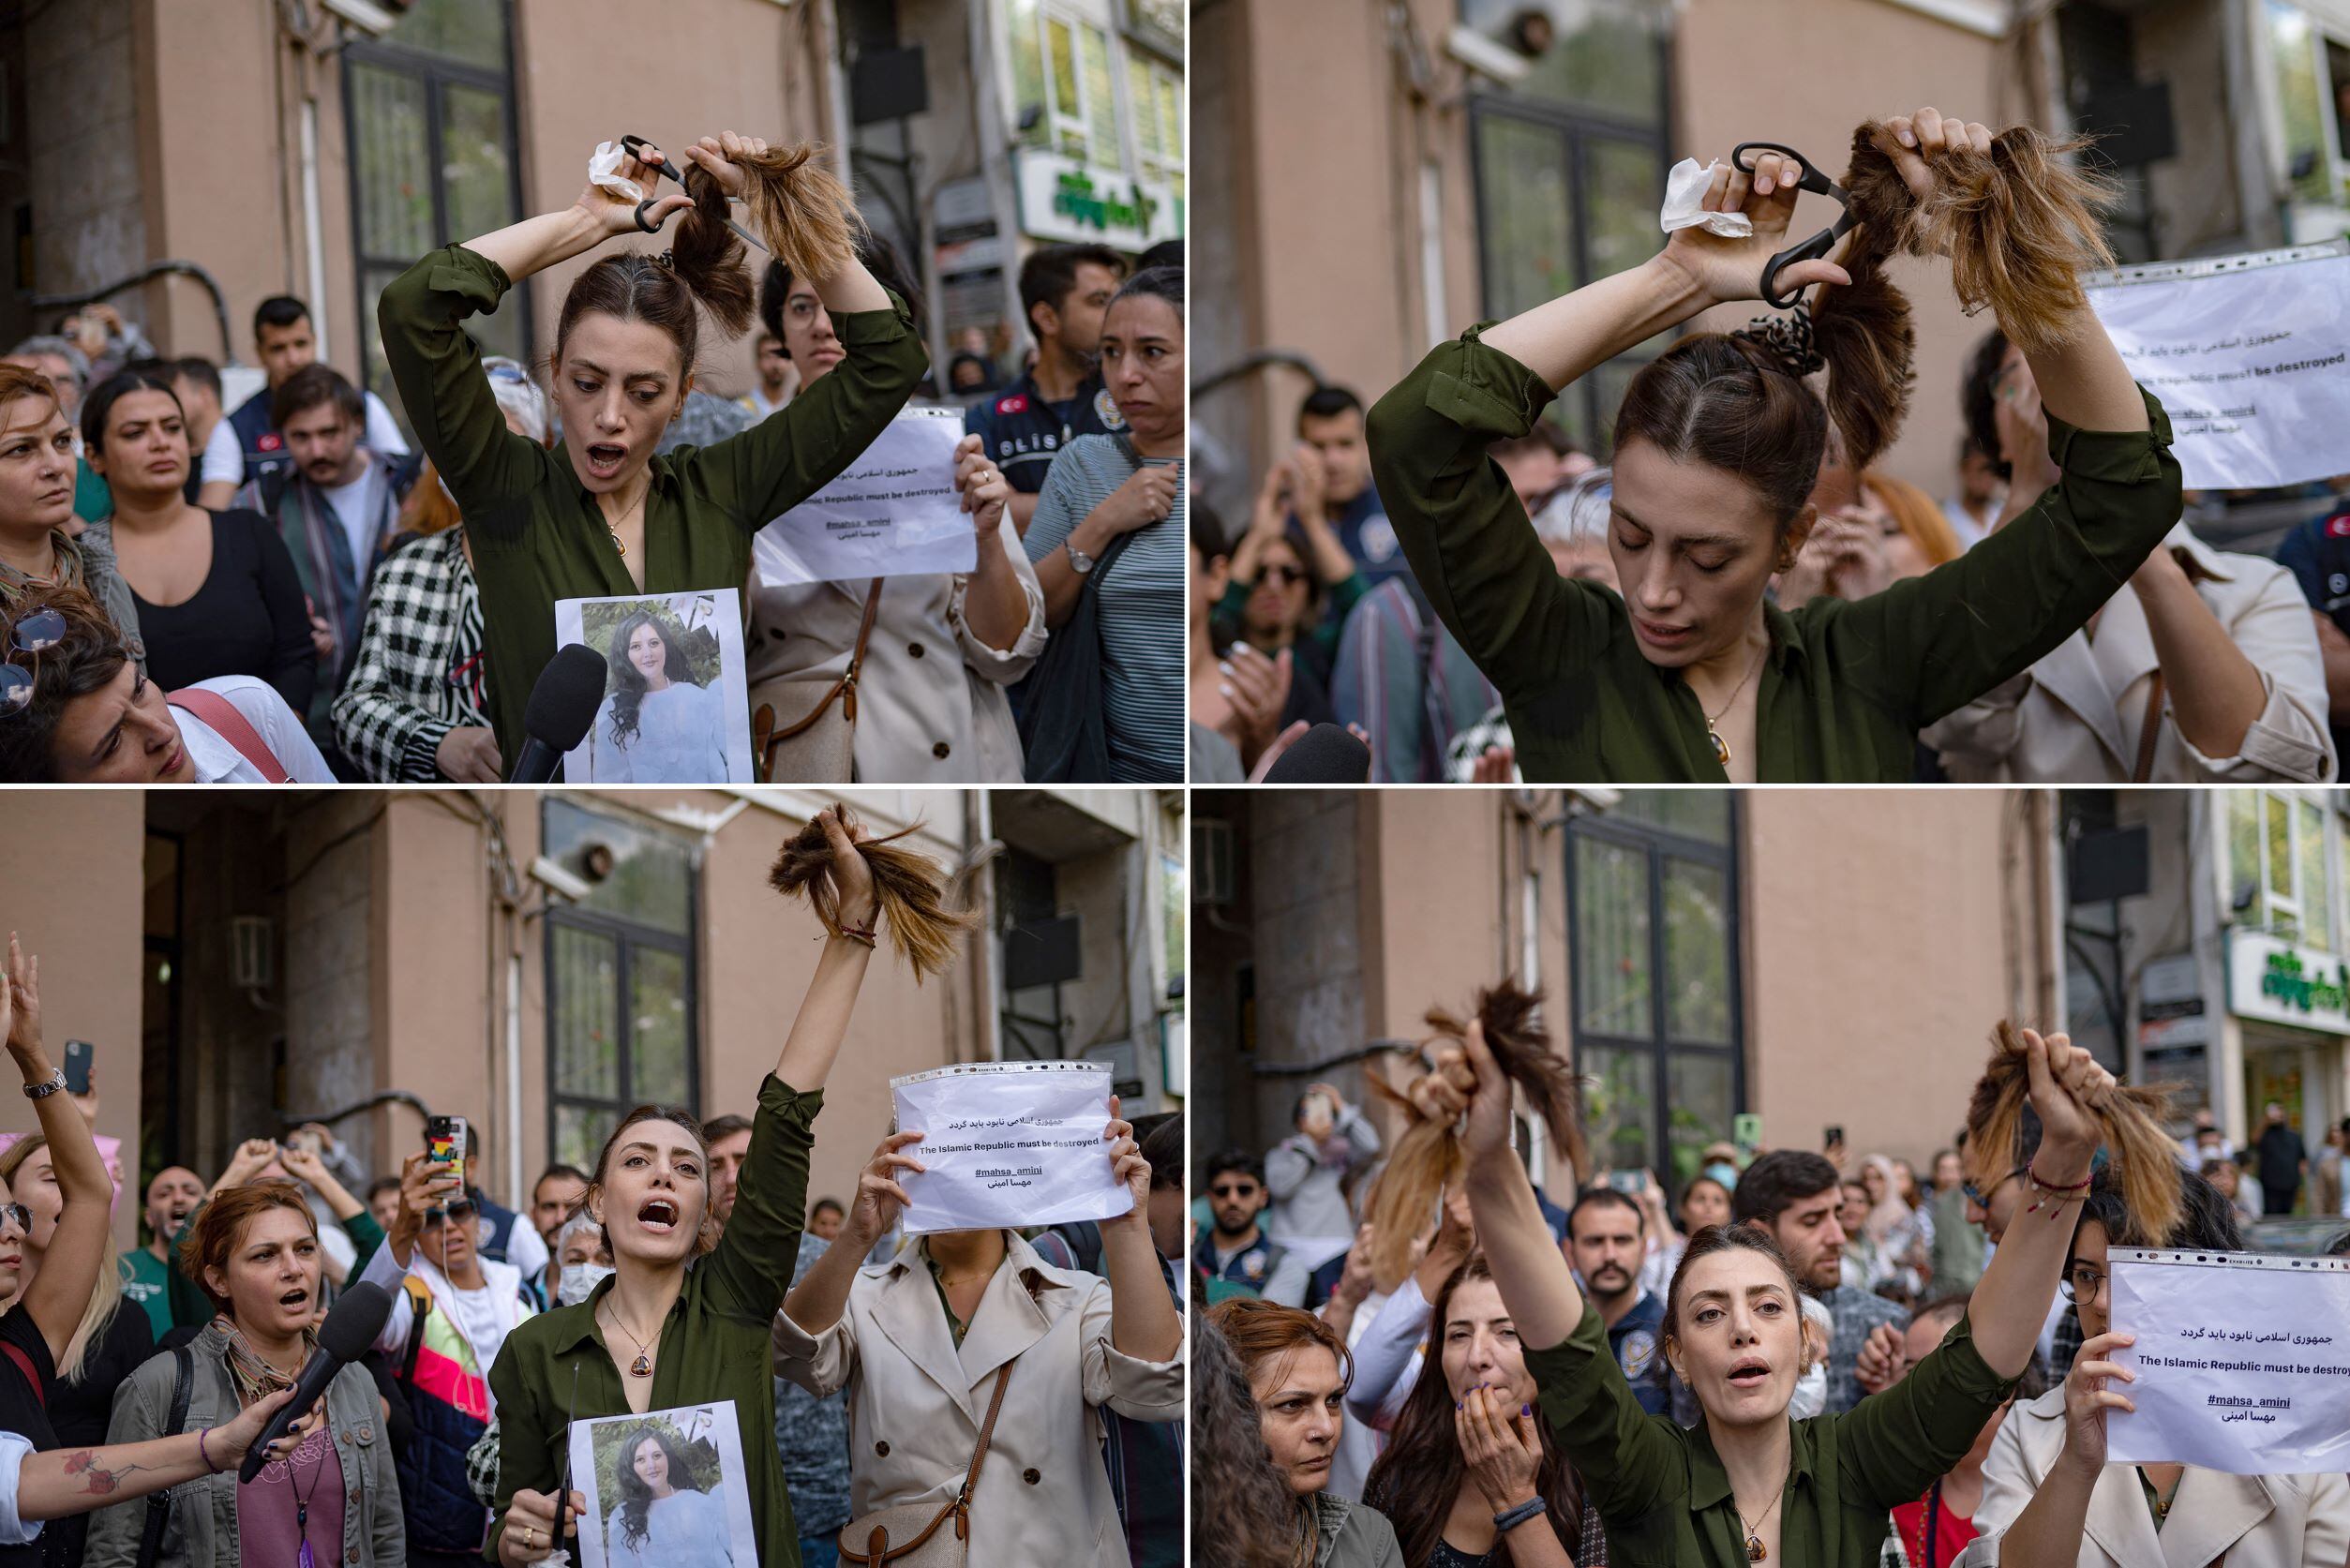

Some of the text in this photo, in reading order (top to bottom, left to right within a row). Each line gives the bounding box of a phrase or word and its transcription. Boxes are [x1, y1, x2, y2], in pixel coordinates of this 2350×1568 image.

[2254, 366, 2272, 377] be
[2275, 353, 2345, 372] destroyed
[824, 493, 864, 504] Republic
[866, 492, 890, 500] must
[891, 490, 903, 500] be
[905, 486, 951, 499] destroyed
[919, 1137, 1100, 1156] The Islamic Republic must be destroyed
[975, 1165, 1042, 1178] #mahsa_amini
[2180, 1327, 2333, 1345] جمهوری اسلامی نابود باید گردد
[2138, 1355, 2162, 1366] The
[2164, 1357, 2208, 1369] Islamic
[2210, 1360, 2261, 1372] Republic
[2264, 1363, 2294, 1373] must
[2297, 1364, 2311, 1374] be
[2208, 1395, 2291, 1410] #mahsa_amini
[2221, 1411, 2276, 1424] مهسا امینی
